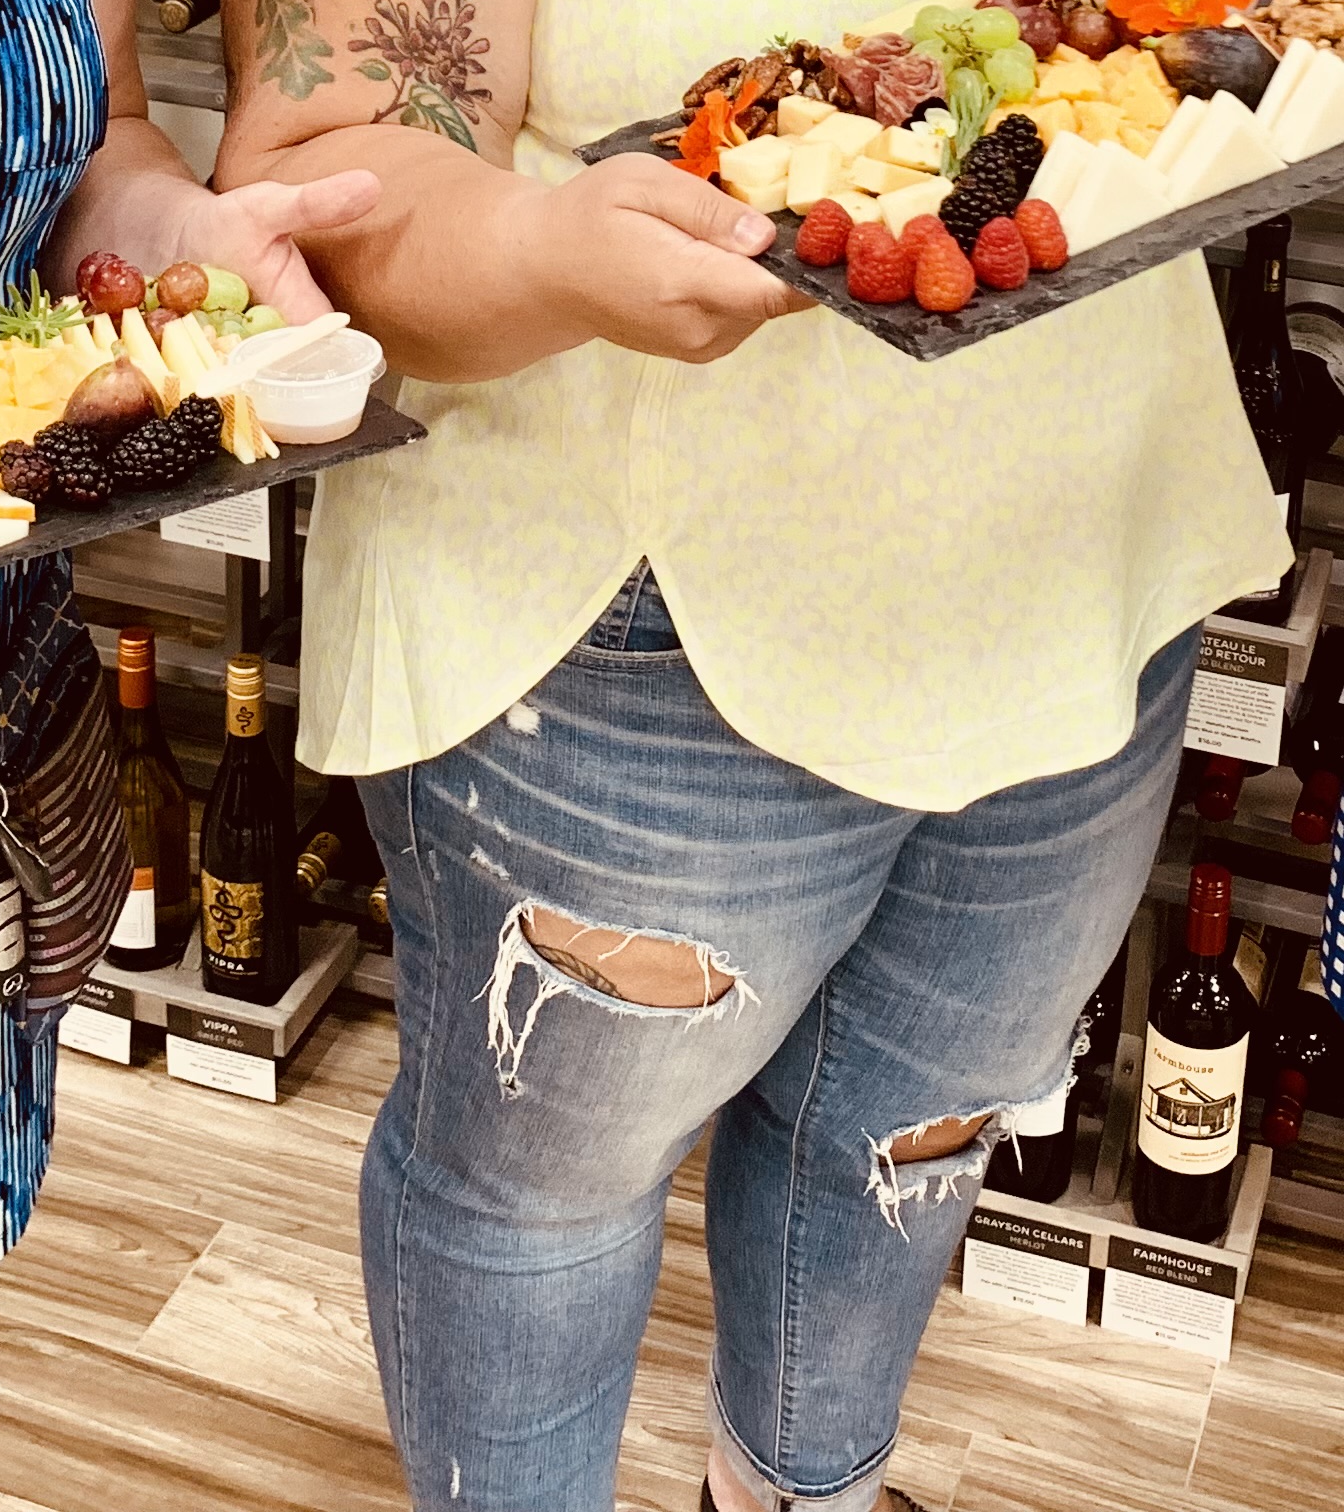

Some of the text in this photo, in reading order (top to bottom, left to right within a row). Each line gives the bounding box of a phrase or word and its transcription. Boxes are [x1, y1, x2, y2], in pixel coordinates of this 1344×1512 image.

[1216, 649, 1266, 667] RETOUR
[1241, 644, 1256, 654] LE
[1211, 660, 1245, 673] BLEND
[208, 953, 245, 971] VIPRA
[202, 1018, 238, 1035] VIPRA
[1154, 1048, 1214, 1073] farmhouse
[974, 1214, 1085, 1250] GRAYSON CELLARS
[1009, 1236, 1046, 1251] MERLOT
[1132, 1247, 1213, 1277] FARMHOUSE
[1145, 1263, 1198, 1283] RED BLEND
